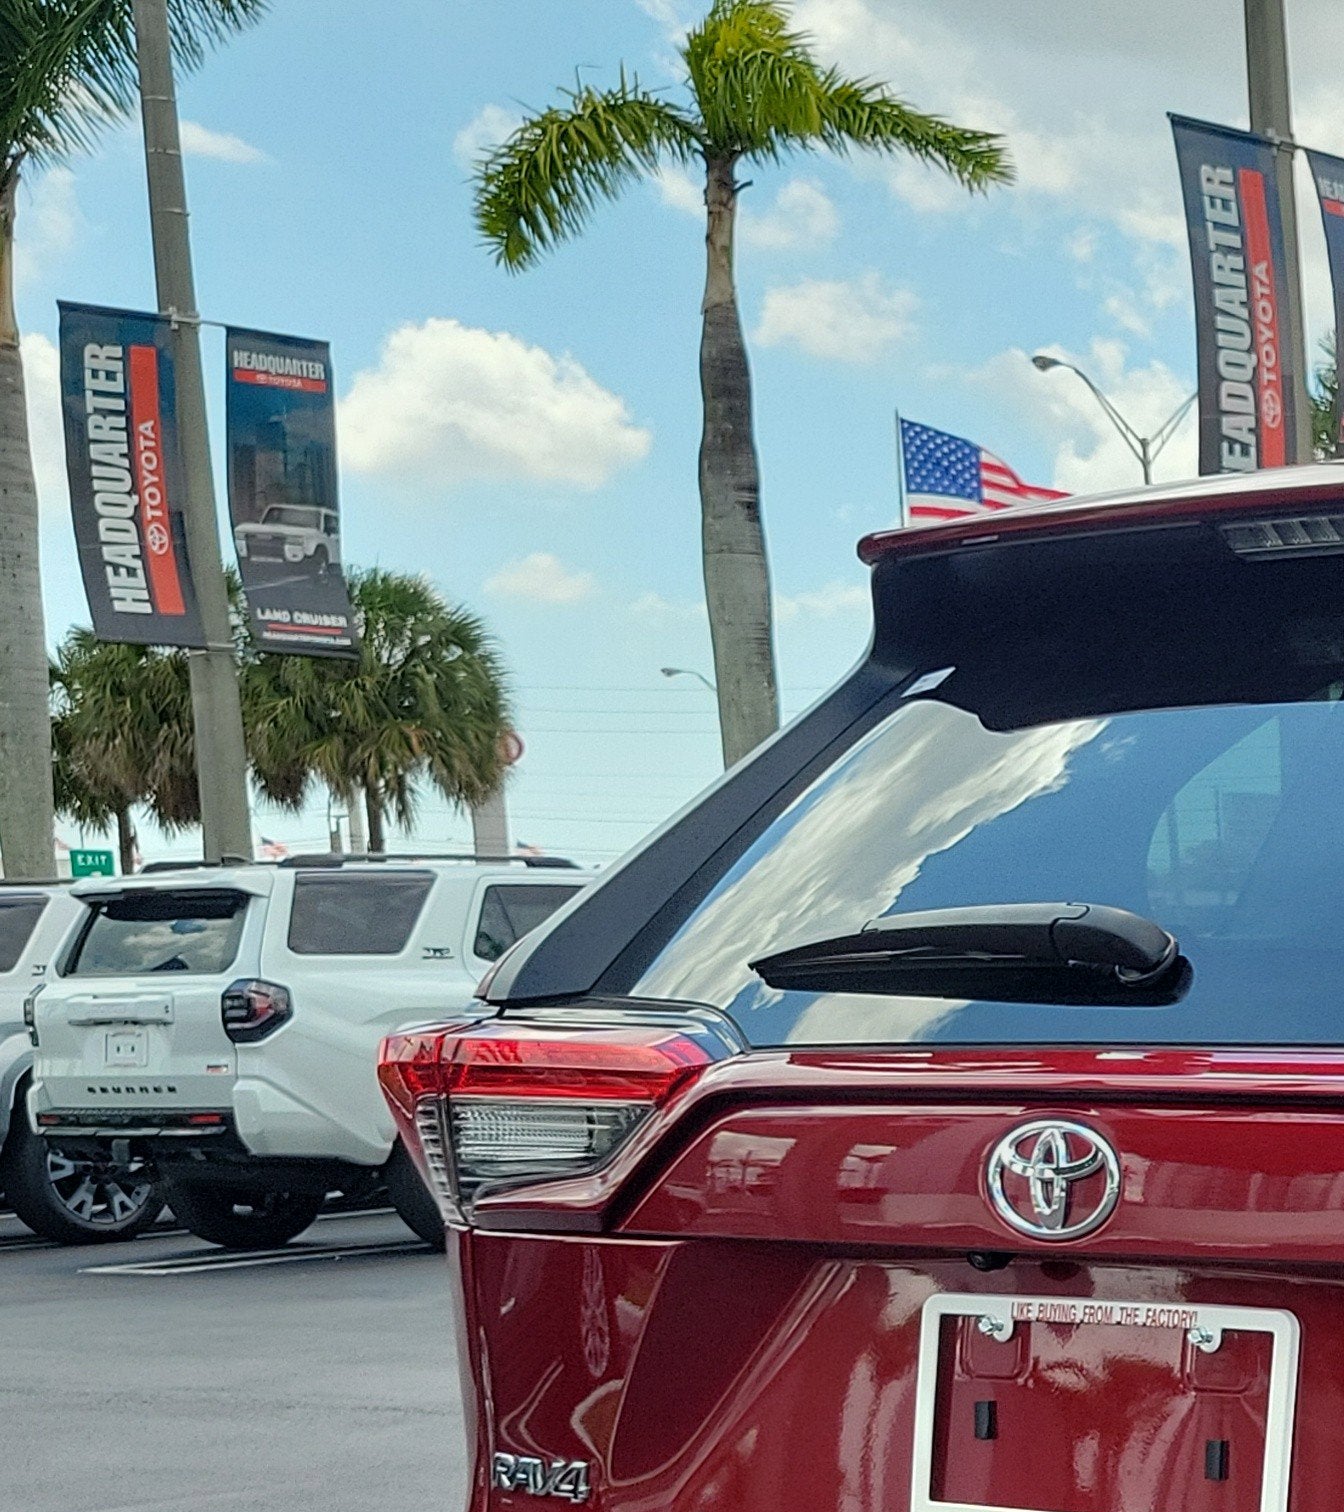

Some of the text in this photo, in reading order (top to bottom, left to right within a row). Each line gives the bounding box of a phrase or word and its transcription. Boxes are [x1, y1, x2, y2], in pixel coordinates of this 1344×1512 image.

[1201, 163, 1257, 473] EADQUARTER
[1253, 261, 1277, 383] TOYOTA
[233, 350, 325, 379] HEADQUARTER
[82, 342, 153, 615] HEADQUARTER
[138, 420, 166, 521] TOYOTA
[257, 608, 291, 622] LAND
[77, 854, 107, 866] EXIT
[1010, 1302, 1198, 1329] LIKE BUYING FROM THE FACTORY!
[494, 1451, 590, 1503] RAV4
